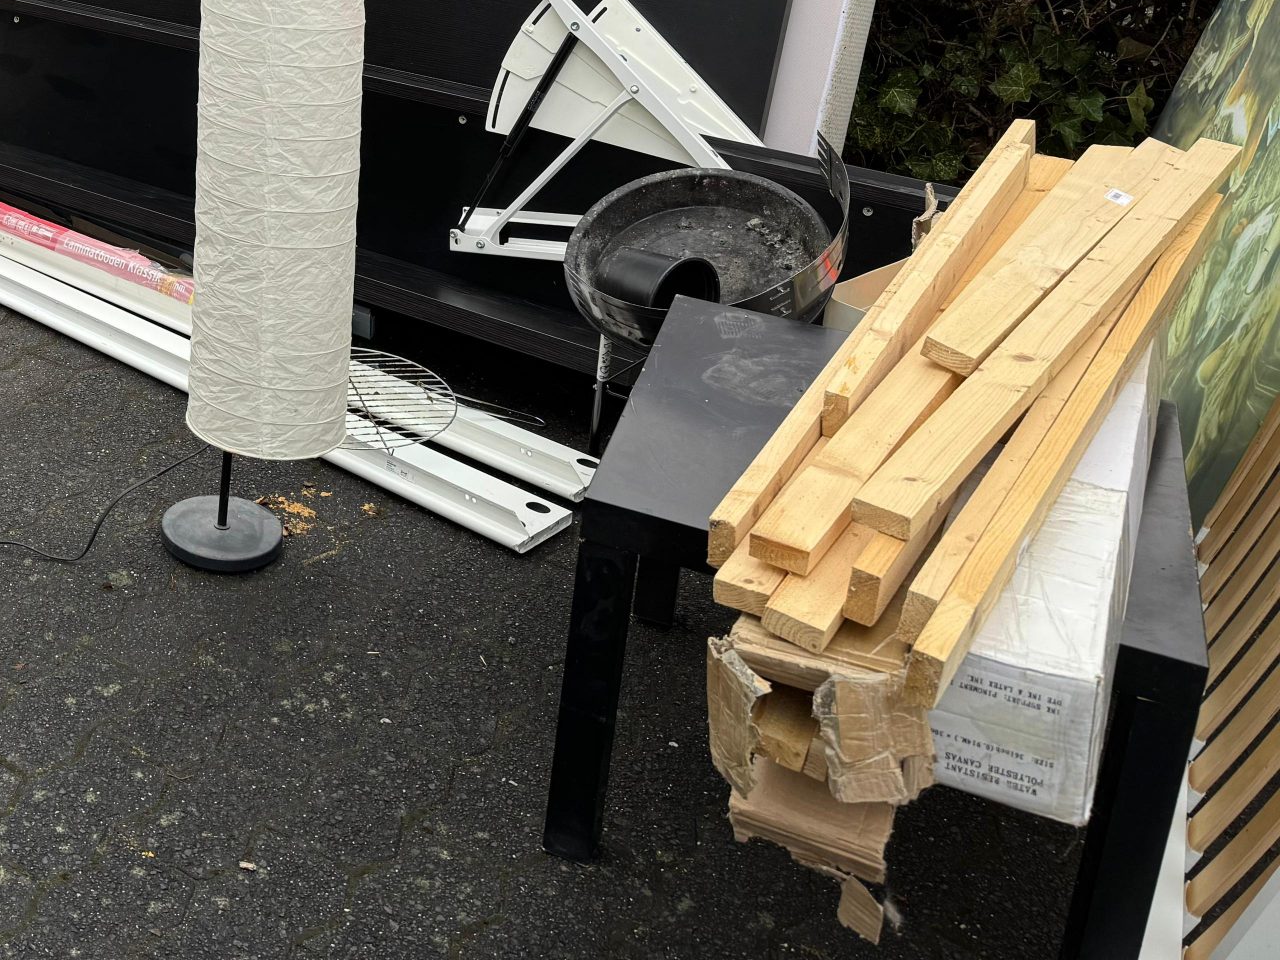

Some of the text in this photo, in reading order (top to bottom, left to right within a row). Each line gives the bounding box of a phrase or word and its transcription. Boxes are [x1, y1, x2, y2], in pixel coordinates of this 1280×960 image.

[63, 237, 126, 270] Laminatboden
[128, 262, 162, 283] Klassik
[988, 680, 1014, 693] LATEX
[1027, 690, 1042, 700] INK
[1047, 697, 1063, 707] DYE
[1046, 706, 1060, 716] INK
[944, 751, 1044, 786] POLYESTER CANVAS
[944, 762, 1038, 796] WATER RESISTANT
